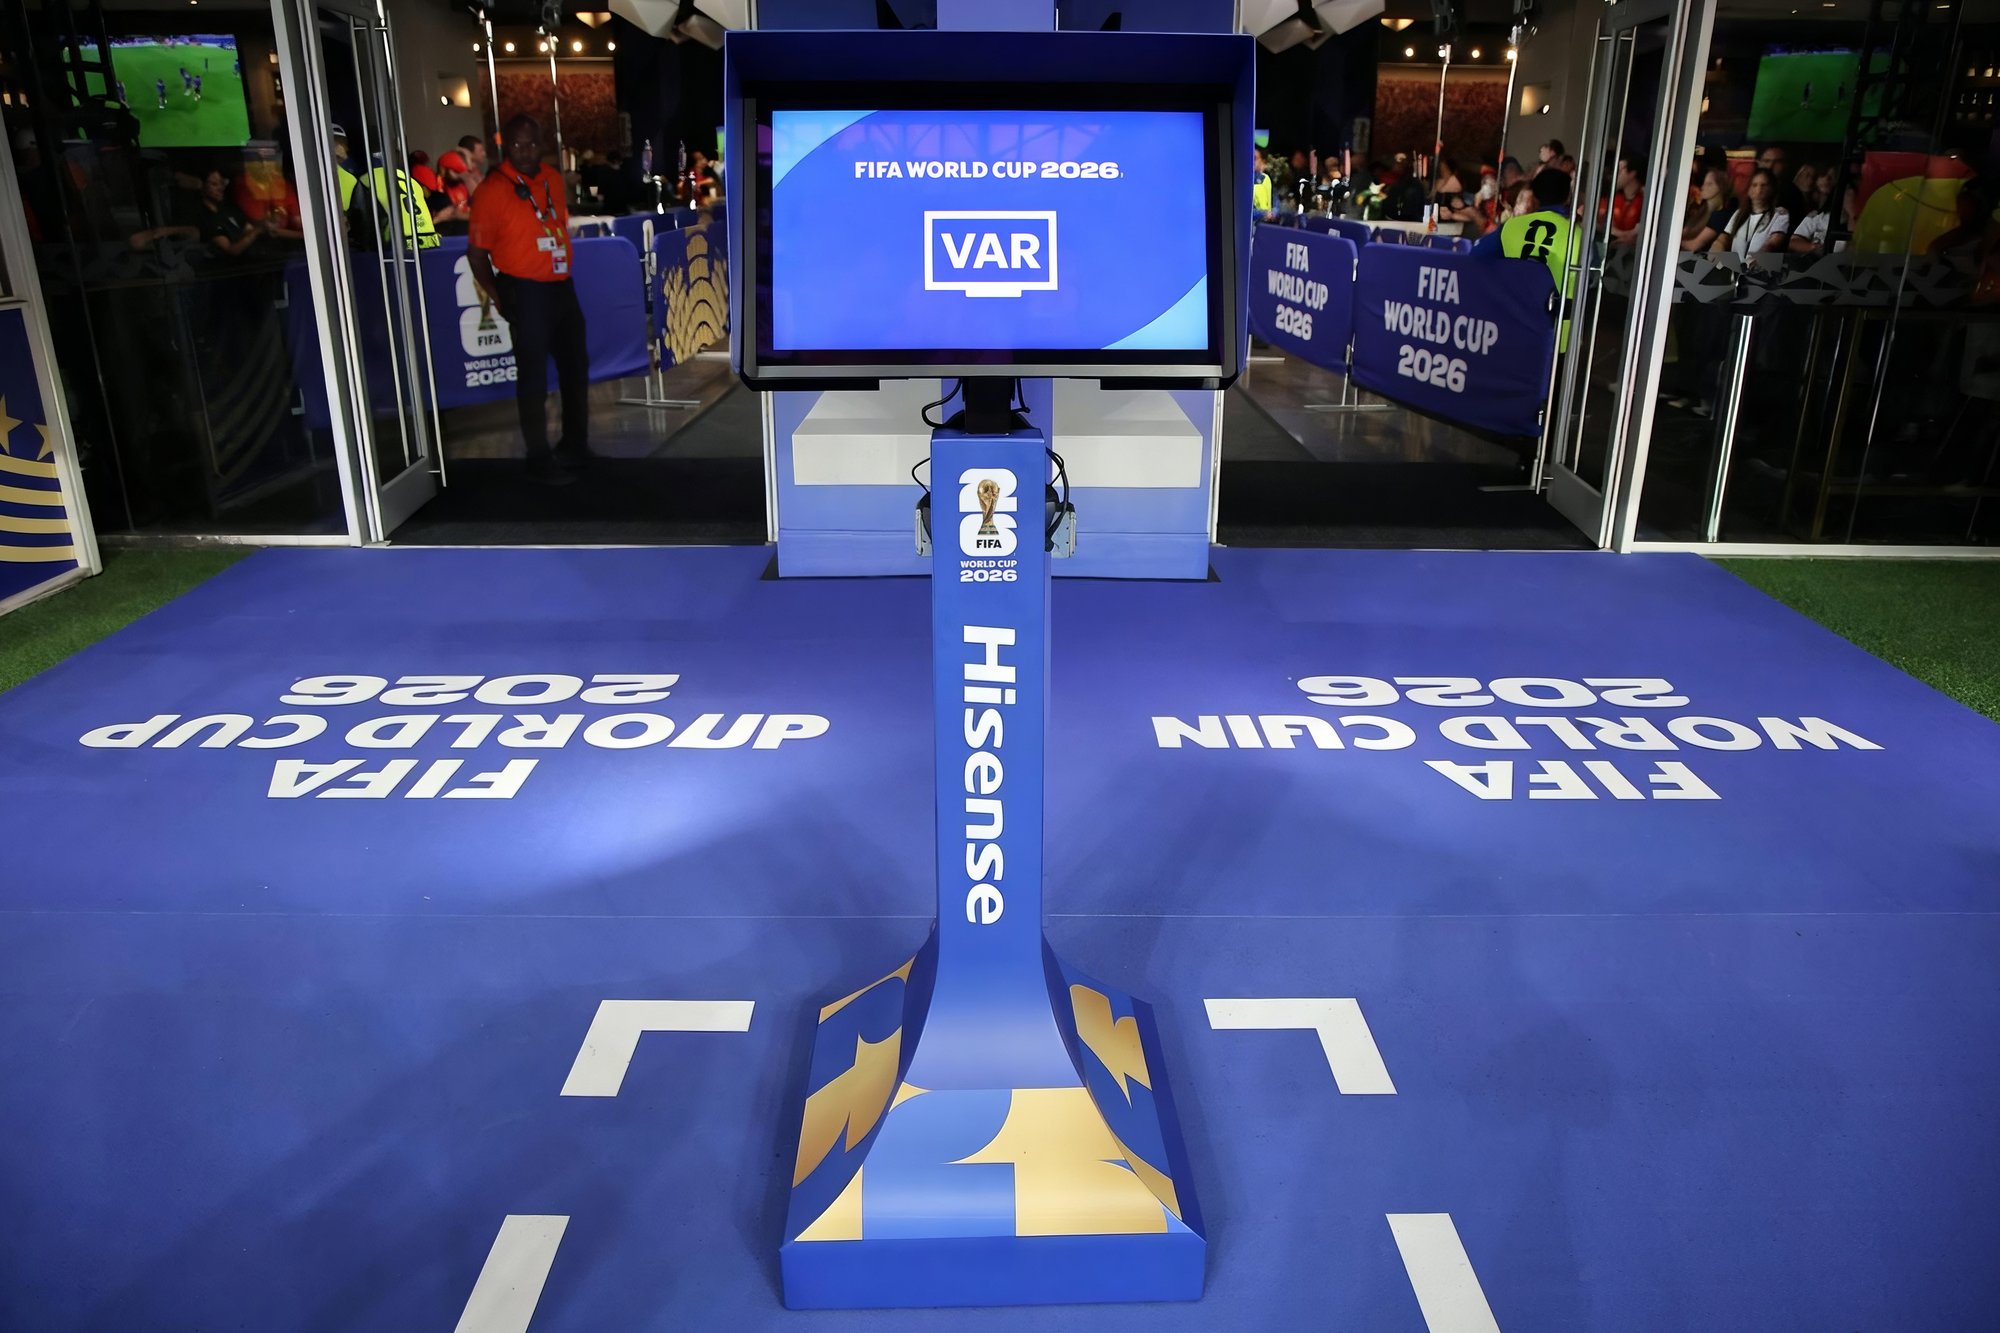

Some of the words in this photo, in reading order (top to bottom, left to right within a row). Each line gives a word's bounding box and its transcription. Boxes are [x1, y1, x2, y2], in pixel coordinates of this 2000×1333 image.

[854, 161, 903, 179] FIFA
[905, 160, 988, 179] WORLD
[991, 161, 1037, 179] CUP
[1040, 161, 1120, 179] 2026
[940, 232, 1041, 269] VAR
[1285, 241, 1310, 273] FIFA
[1267, 269, 1305, 304] WORLD
[1304, 279, 1329, 312] CUP
[1417, 265, 1461, 305] FIFA
[1275, 303, 1313, 342] 2026
[1384, 299, 1451, 346] WORLD
[1453, 314, 1499, 356] CUP
[477, 334, 502, 347] FIFA
[464, 358, 499, 371] WORLD
[1397, 344, 1469, 394] 2026
[976, 540, 1002, 549] FIFA
[960, 560, 996, 568] WORLD
[997, 560, 1018, 568] CUP
[960, 569, 1018, 583] 2026
[279, 674, 680, 706] 2026
[1297, 675, 1690, 708] 2026
[78, 713, 328, 749] CUP
[1438, 716, 1886, 751] WORLD
[267, 759, 540, 799] FIFA
[963, 625, 1017, 925] Hisense
[1423, 760, 1722, 800] FIFA
